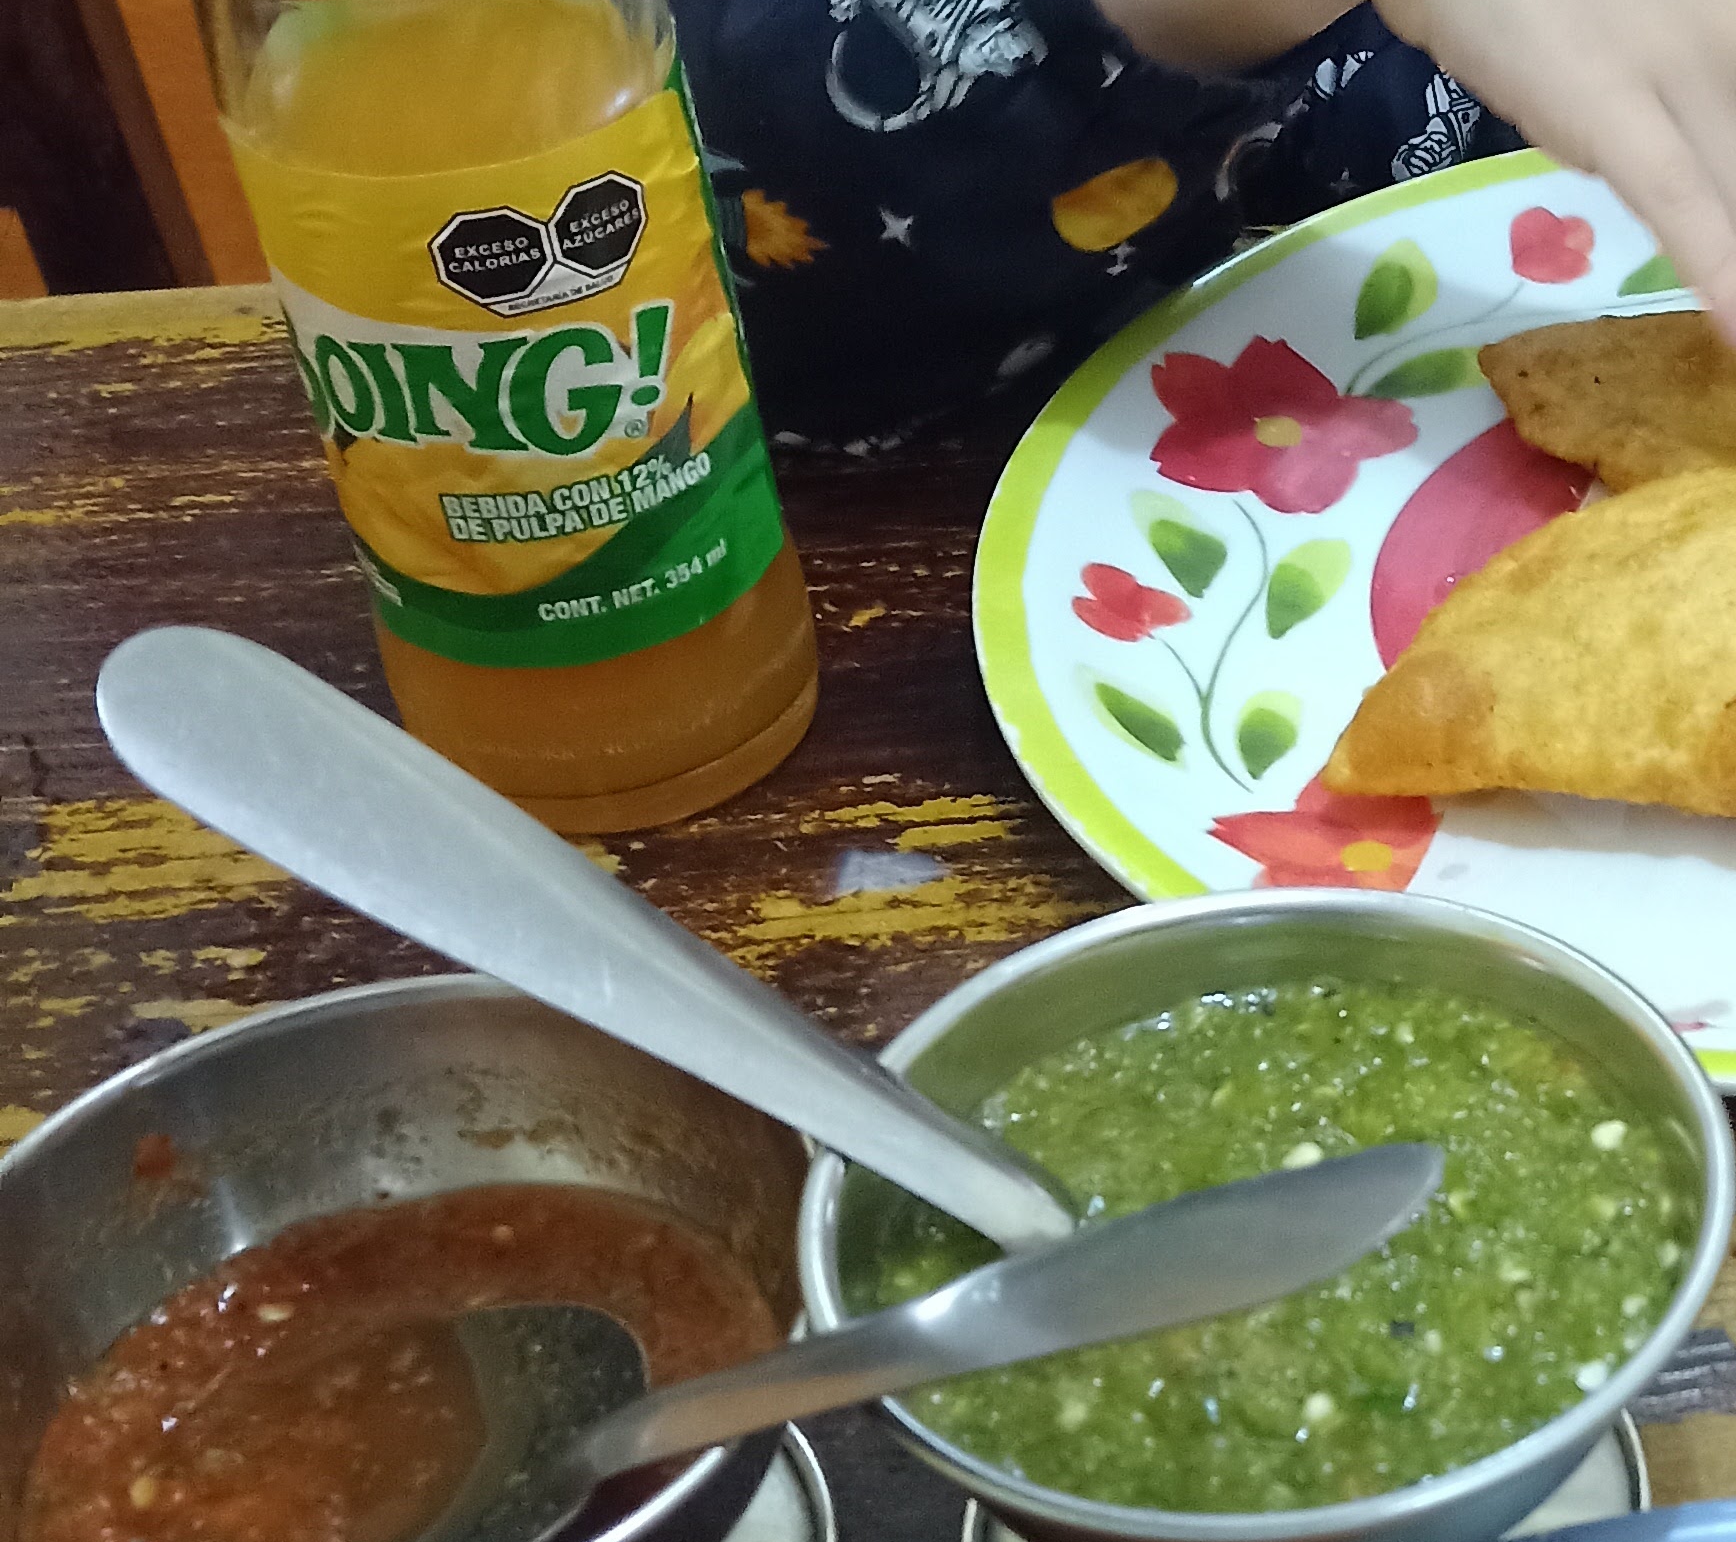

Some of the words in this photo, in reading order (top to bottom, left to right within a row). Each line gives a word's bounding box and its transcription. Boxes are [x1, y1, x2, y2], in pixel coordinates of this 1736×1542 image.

[454, 236, 530, 260] EXCESO
[569, 199, 630, 234] EXCESO
[290, 303, 671, 457] OING!
[441, 491, 548, 519] BEBIDA
[552, 476, 611, 511] CON
[617, 454, 672, 495] 12%
[452, 517, 489, 542] DE
[491, 507, 586, 542] PULPA
[589, 497, 628, 527] DE
[631, 451, 712, 513] MANGO
[537, 595, 608, 622] CONT.
[611, 577, 661, 610] NET.
[664, 555, 703, 589] 354
[705, 538, 728, 568] ml
